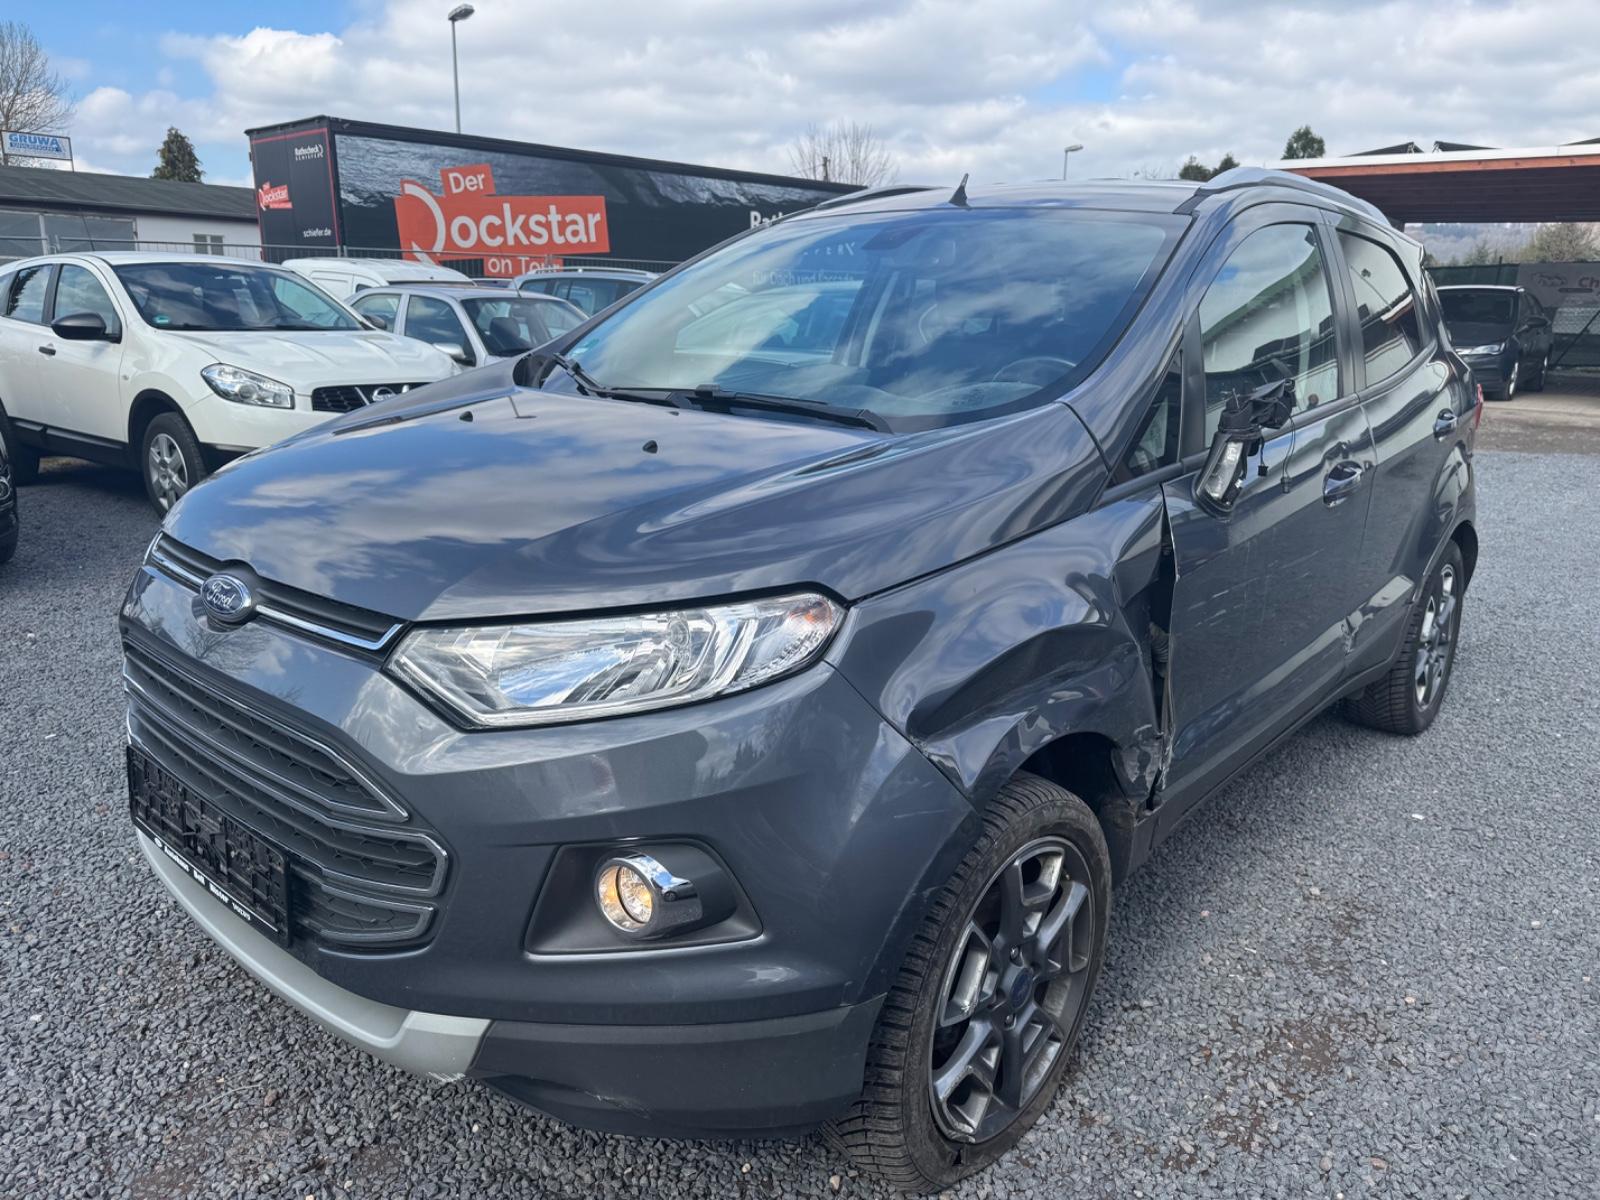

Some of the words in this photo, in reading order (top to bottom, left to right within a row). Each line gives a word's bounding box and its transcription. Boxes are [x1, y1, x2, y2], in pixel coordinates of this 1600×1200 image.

[9, 133, 60, 148] GRUWA
[448, 172, 485, 193] Der
[303, 227, 332, 238] schiefer.de
[488, 258, 512, 274] on
[206, 580, 236, 609] Ford
